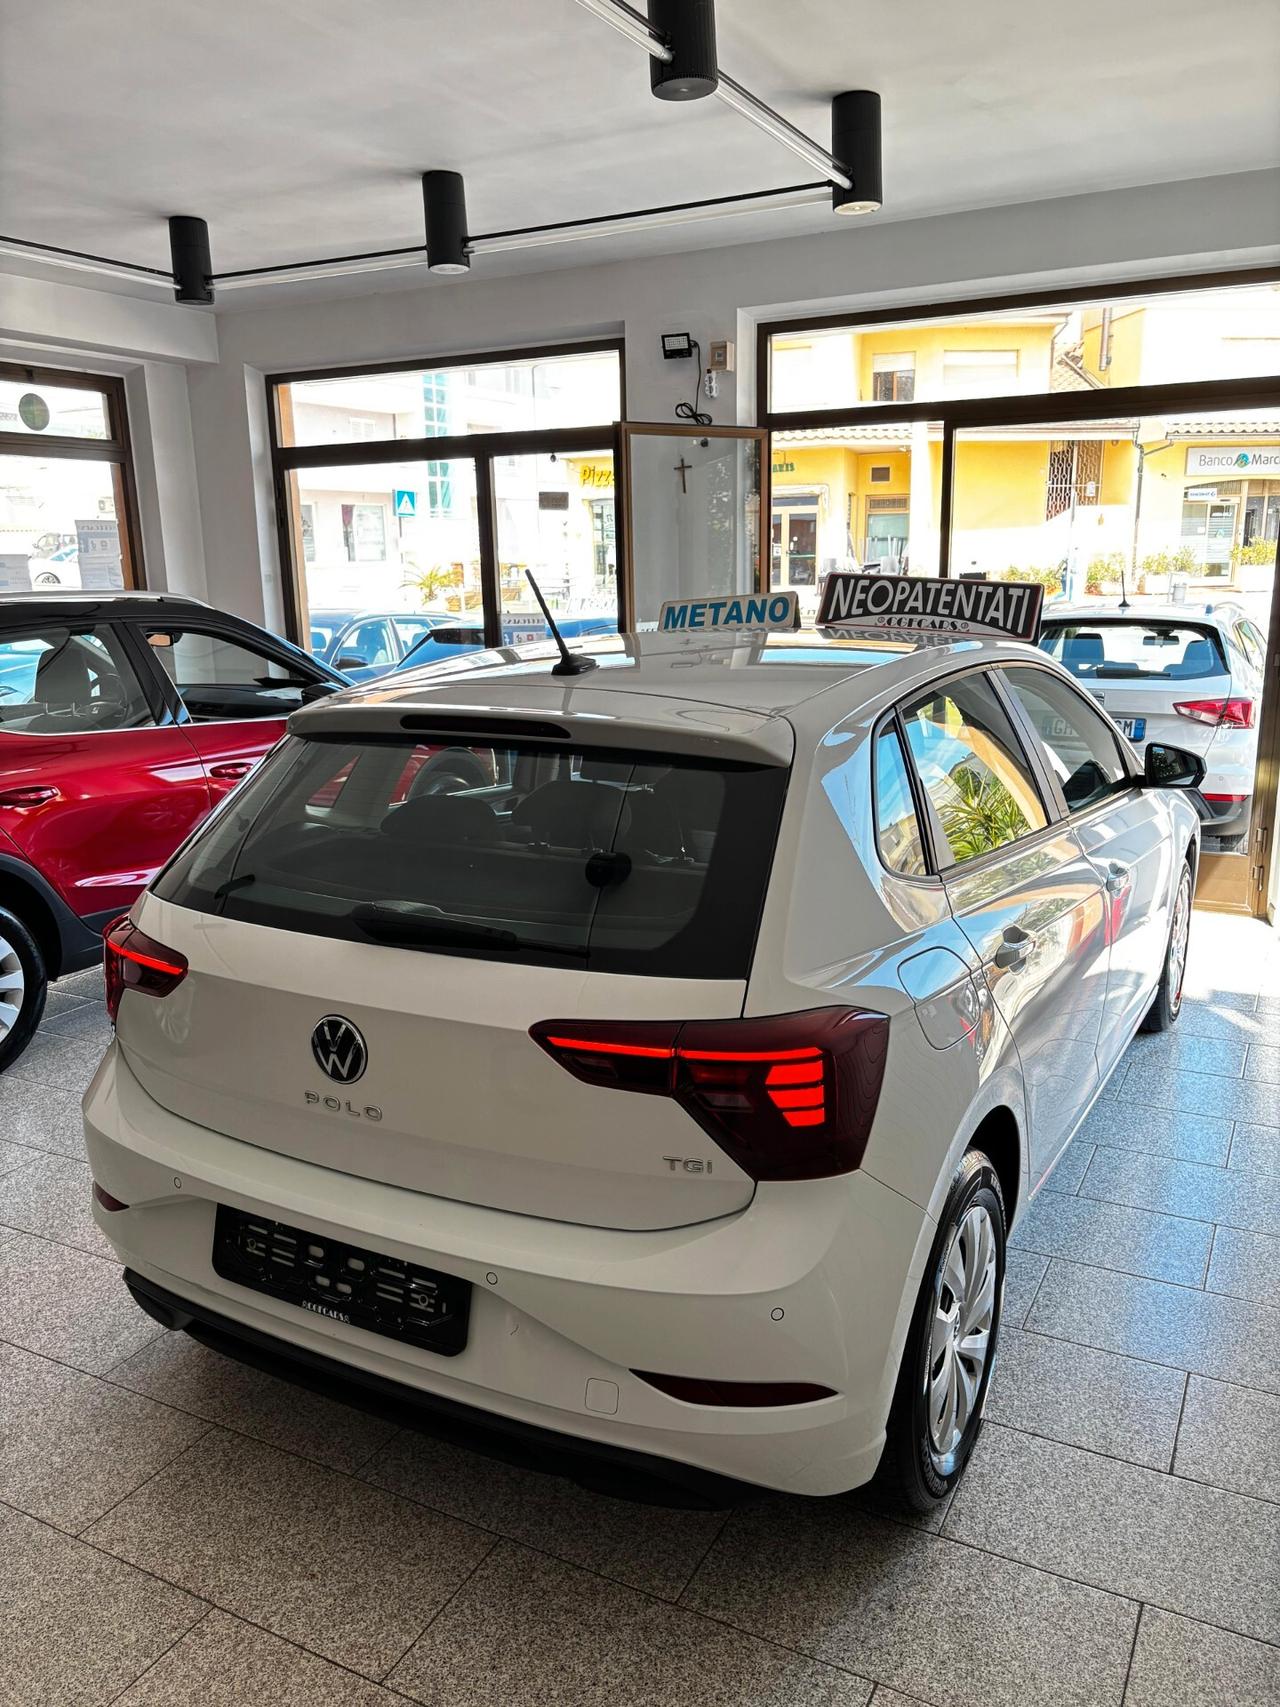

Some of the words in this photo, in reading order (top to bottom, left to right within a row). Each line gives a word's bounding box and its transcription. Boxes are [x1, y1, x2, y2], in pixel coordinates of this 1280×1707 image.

[1199, 454, 1233, 466] Banco
[580, 465, 613, 487] Pizz
[663, 596, 790, 630] METANO
[828, 578, 1031, 633] NEOPATENTATI
[304, 1090, 383, 1122] POLO
[662, 1155, 713, 1174] TGI
